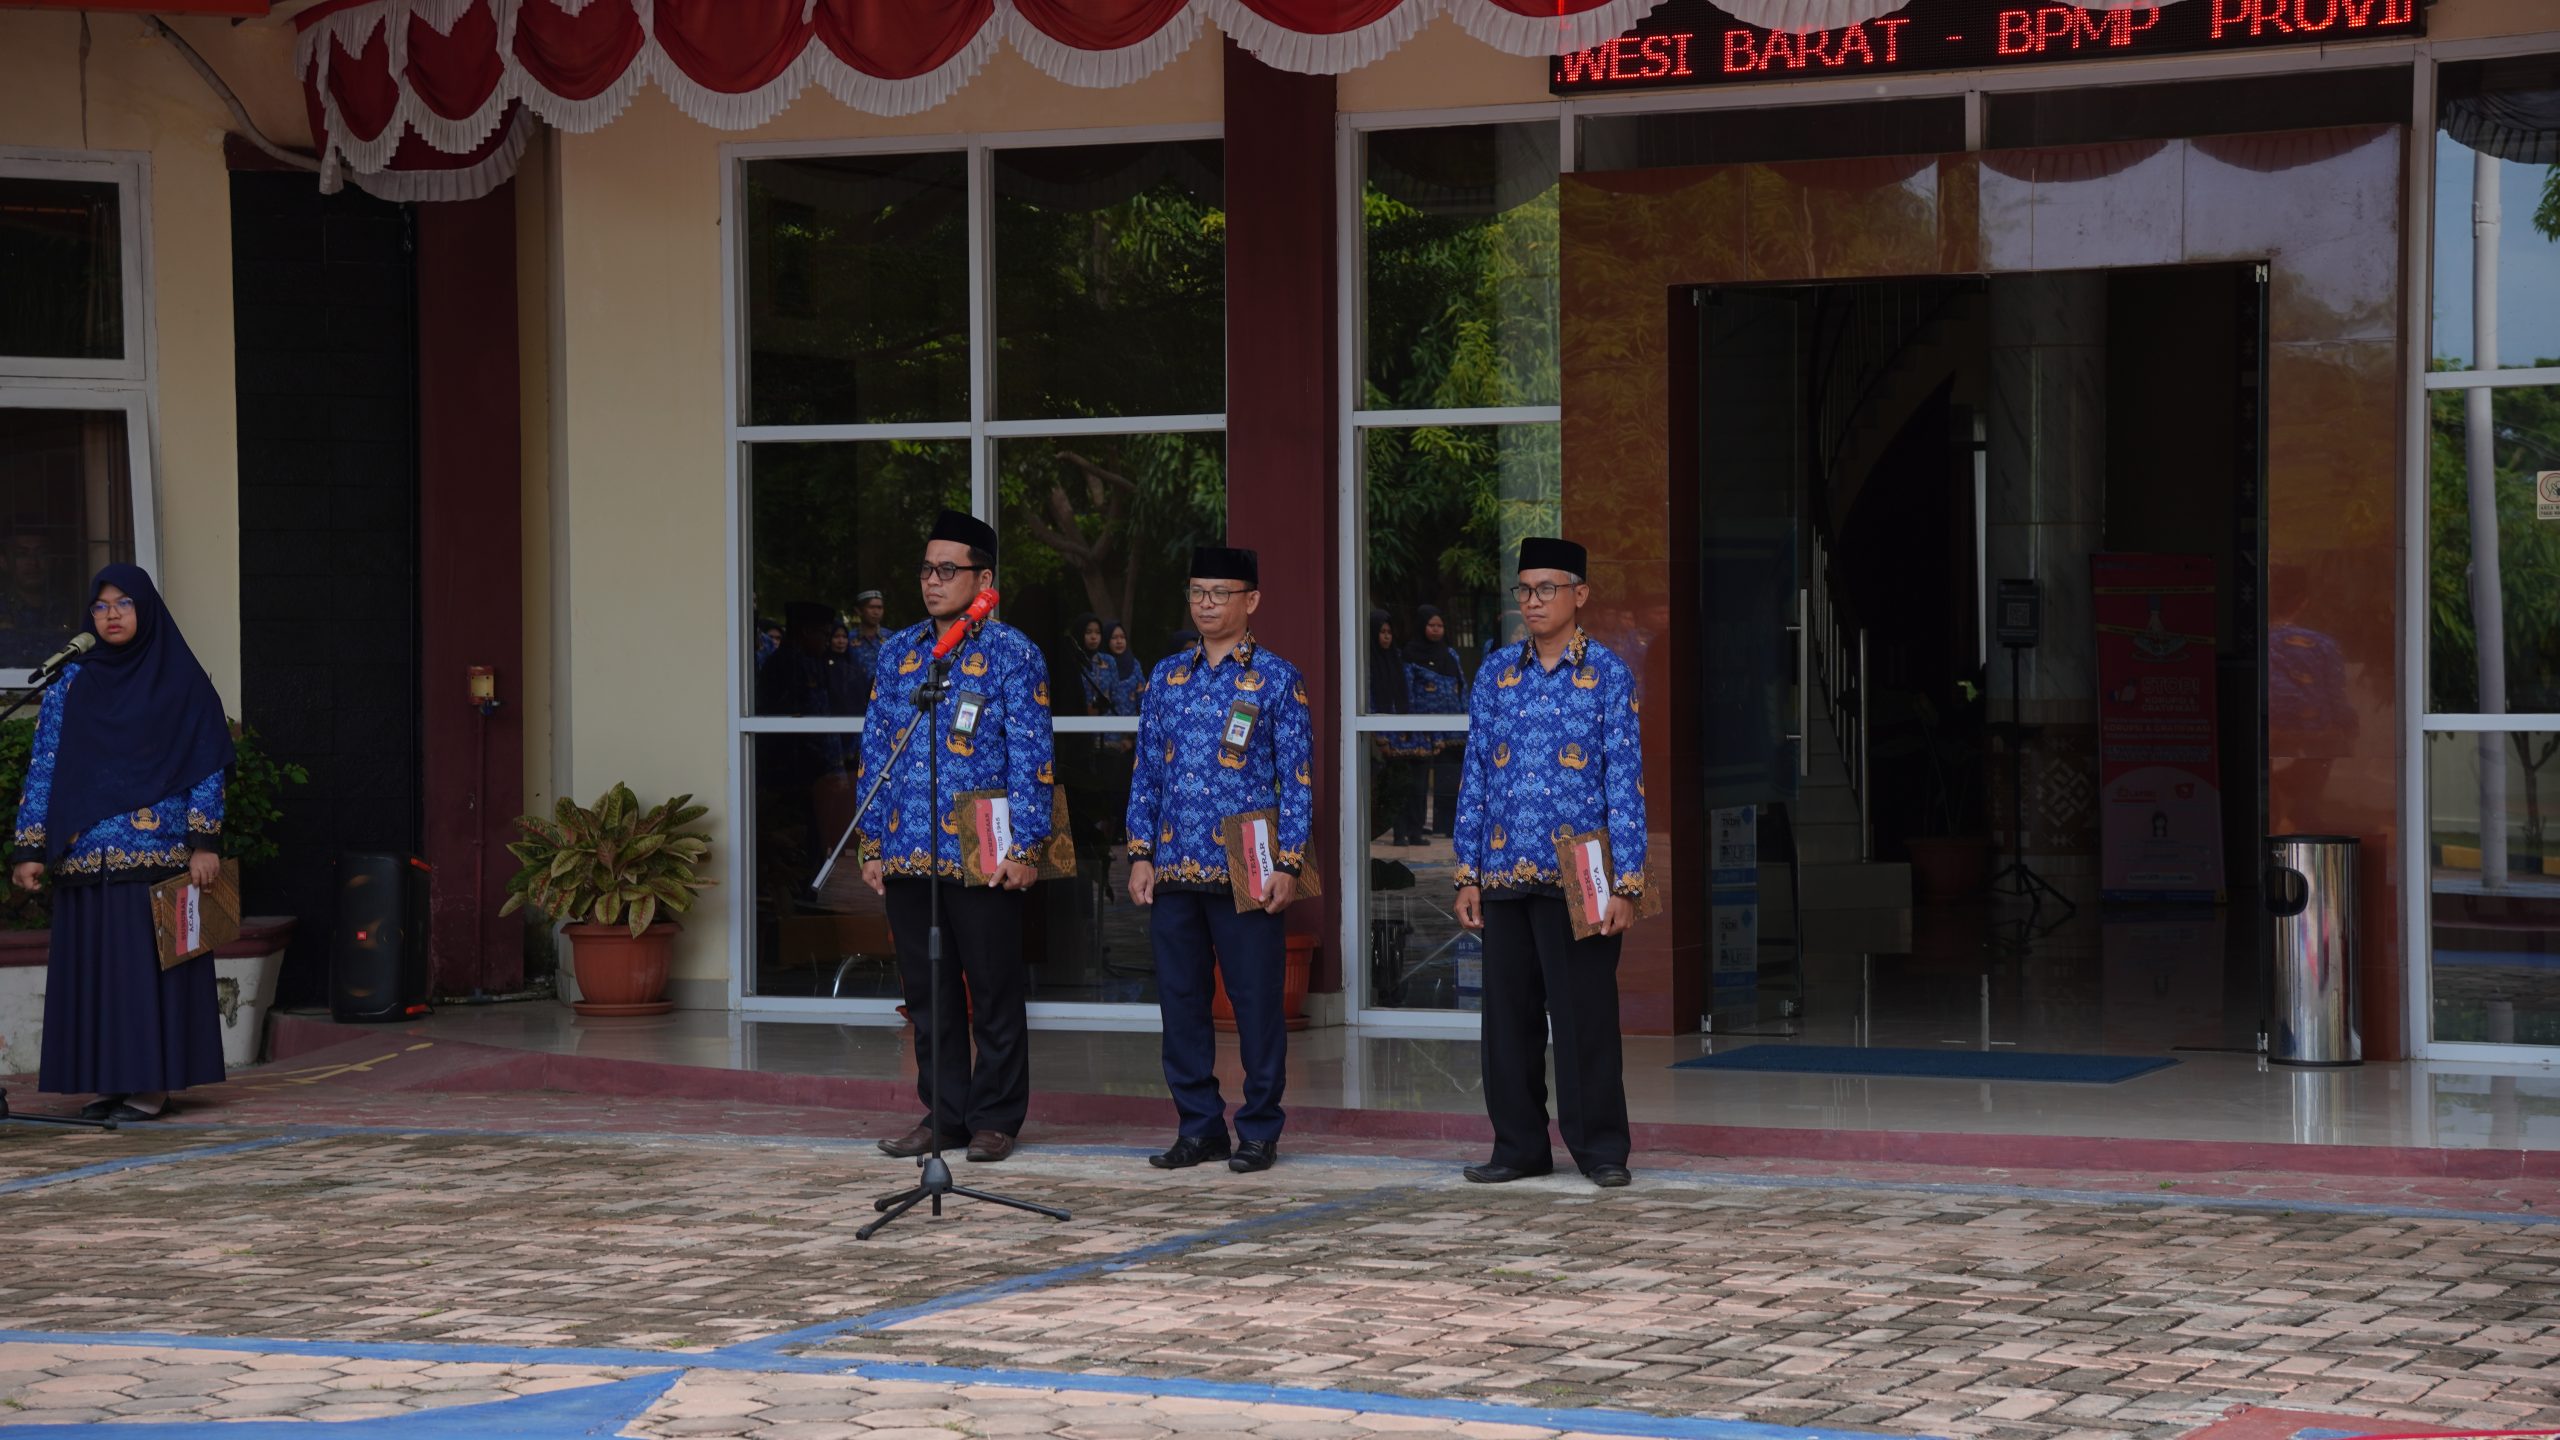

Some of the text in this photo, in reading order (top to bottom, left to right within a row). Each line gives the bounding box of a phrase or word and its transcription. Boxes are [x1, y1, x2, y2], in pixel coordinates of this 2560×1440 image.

[1557, 33, 1694, 82] WESI
[1723, 19, 1911, 73] BARAT
[1999, 7, 2160, 54] BPMP
[2210, 0, 2413, 39] PROVI
[995, 816, 1003, 834] 1945
[1249, 847, 1258, 877] TEKS
[1259, 841, 1270, 877] IKRAR
[1582, 868, 1594, 899] TEKS
